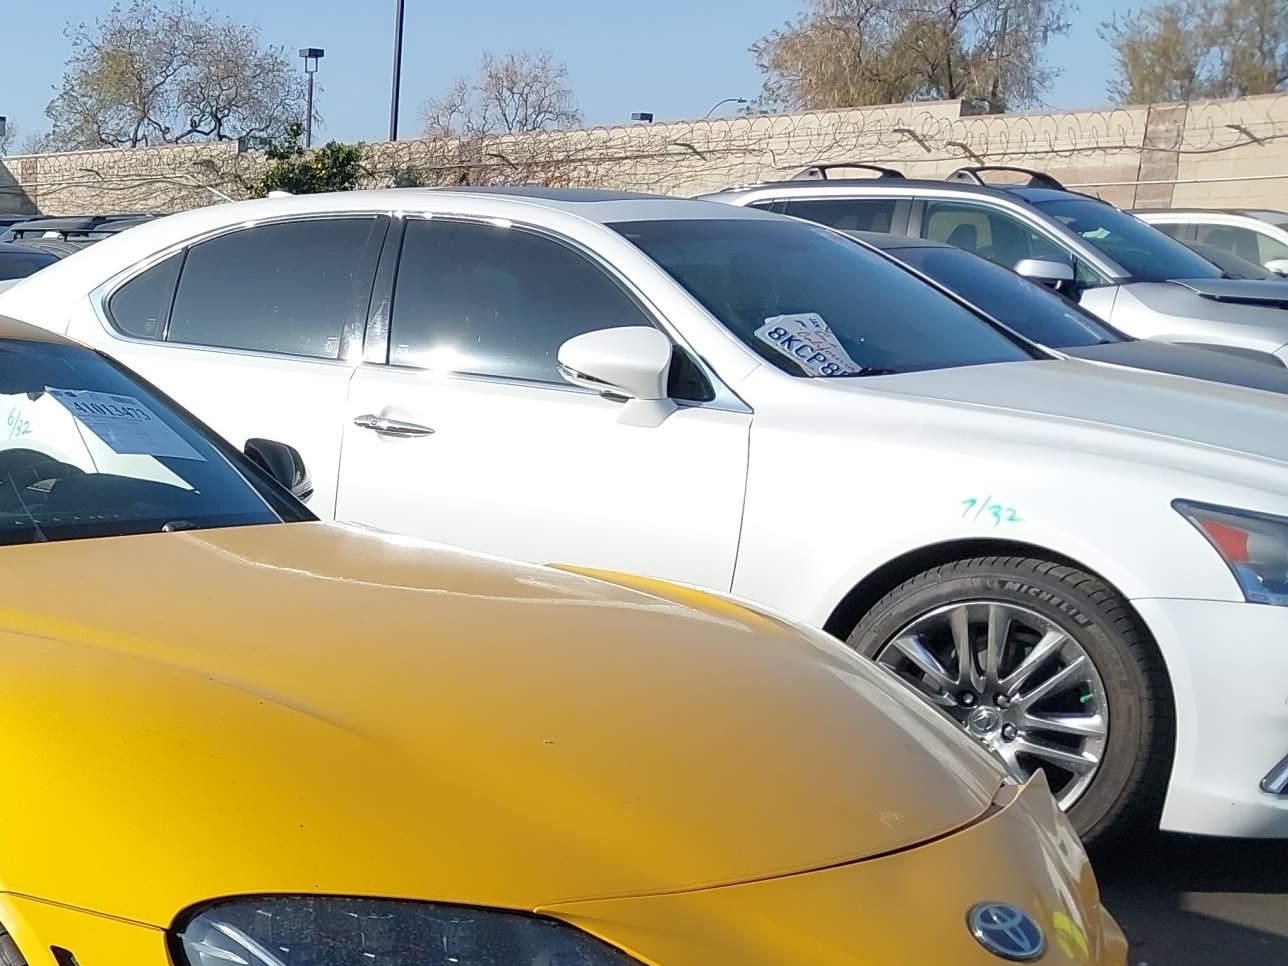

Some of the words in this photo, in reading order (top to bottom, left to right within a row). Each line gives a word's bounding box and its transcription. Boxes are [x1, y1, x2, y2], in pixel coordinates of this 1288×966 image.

[768, 327, 849, 376] 8KCP8
[7, 406, 33, 441] 6/32
[73, 402, 152, 421] 41013473
[1003, 581, 1091, 625] MICHELIN
